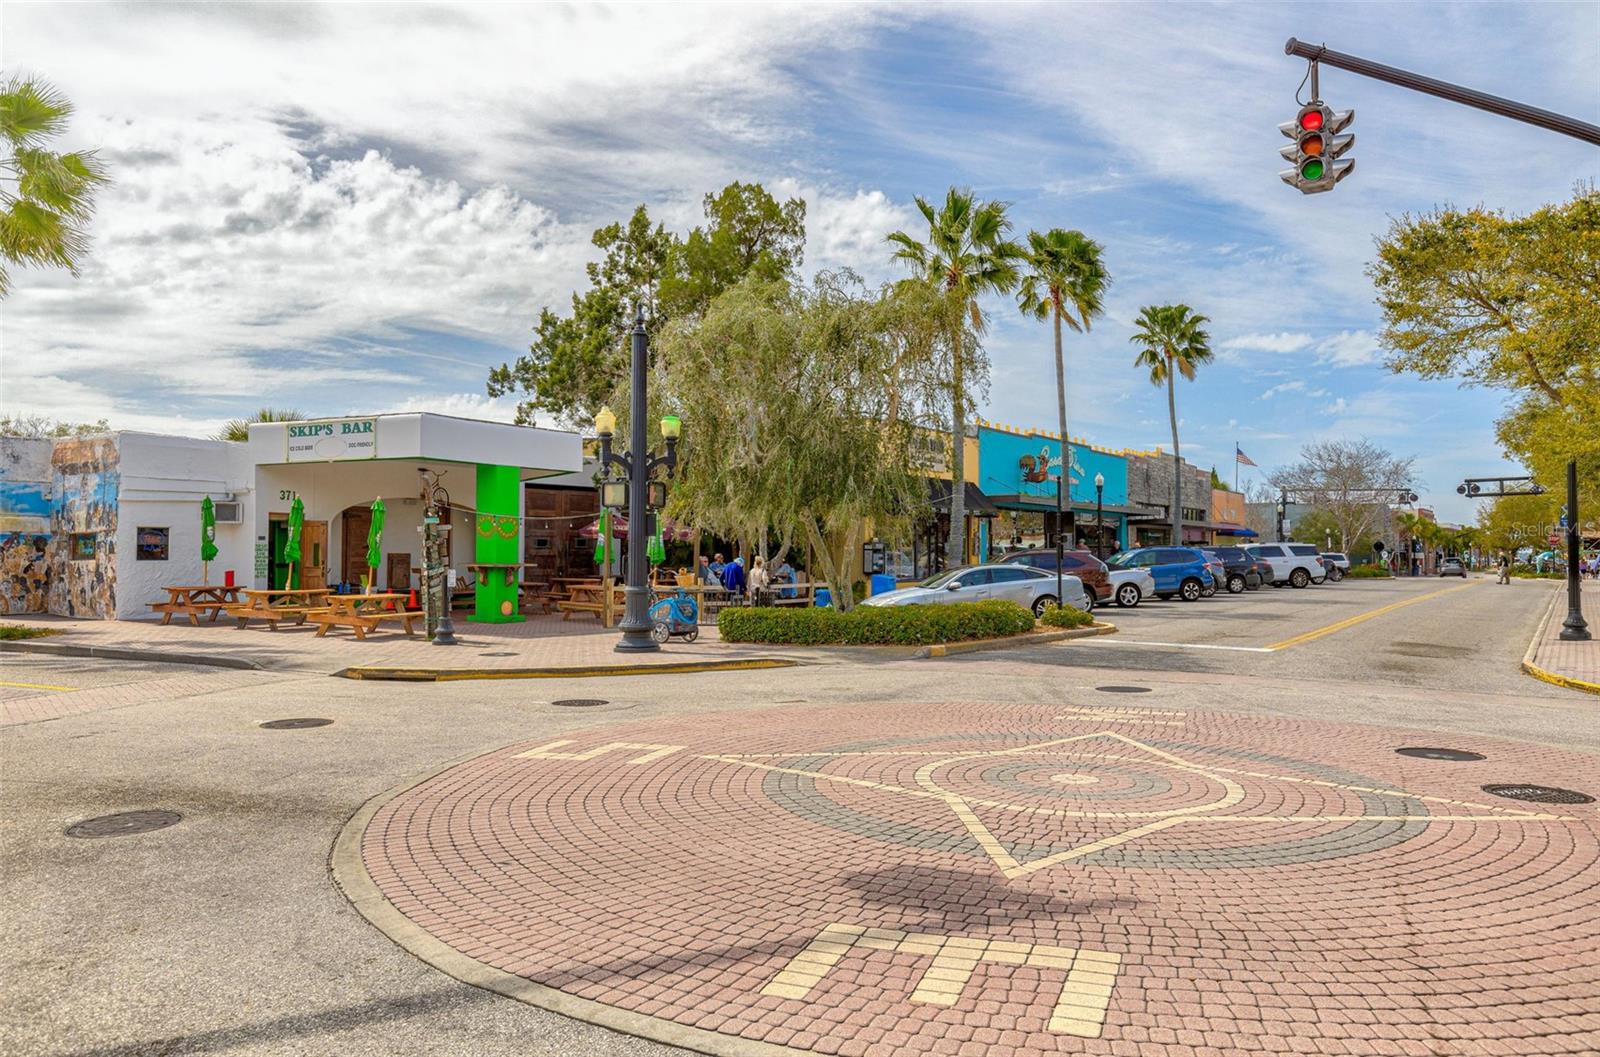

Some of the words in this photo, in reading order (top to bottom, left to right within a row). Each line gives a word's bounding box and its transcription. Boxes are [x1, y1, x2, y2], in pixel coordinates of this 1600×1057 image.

[290, 424, 333, 437] SKIP'S
[341, 421, 374, 434] BAR
[279, 490, 296, 501] 371
